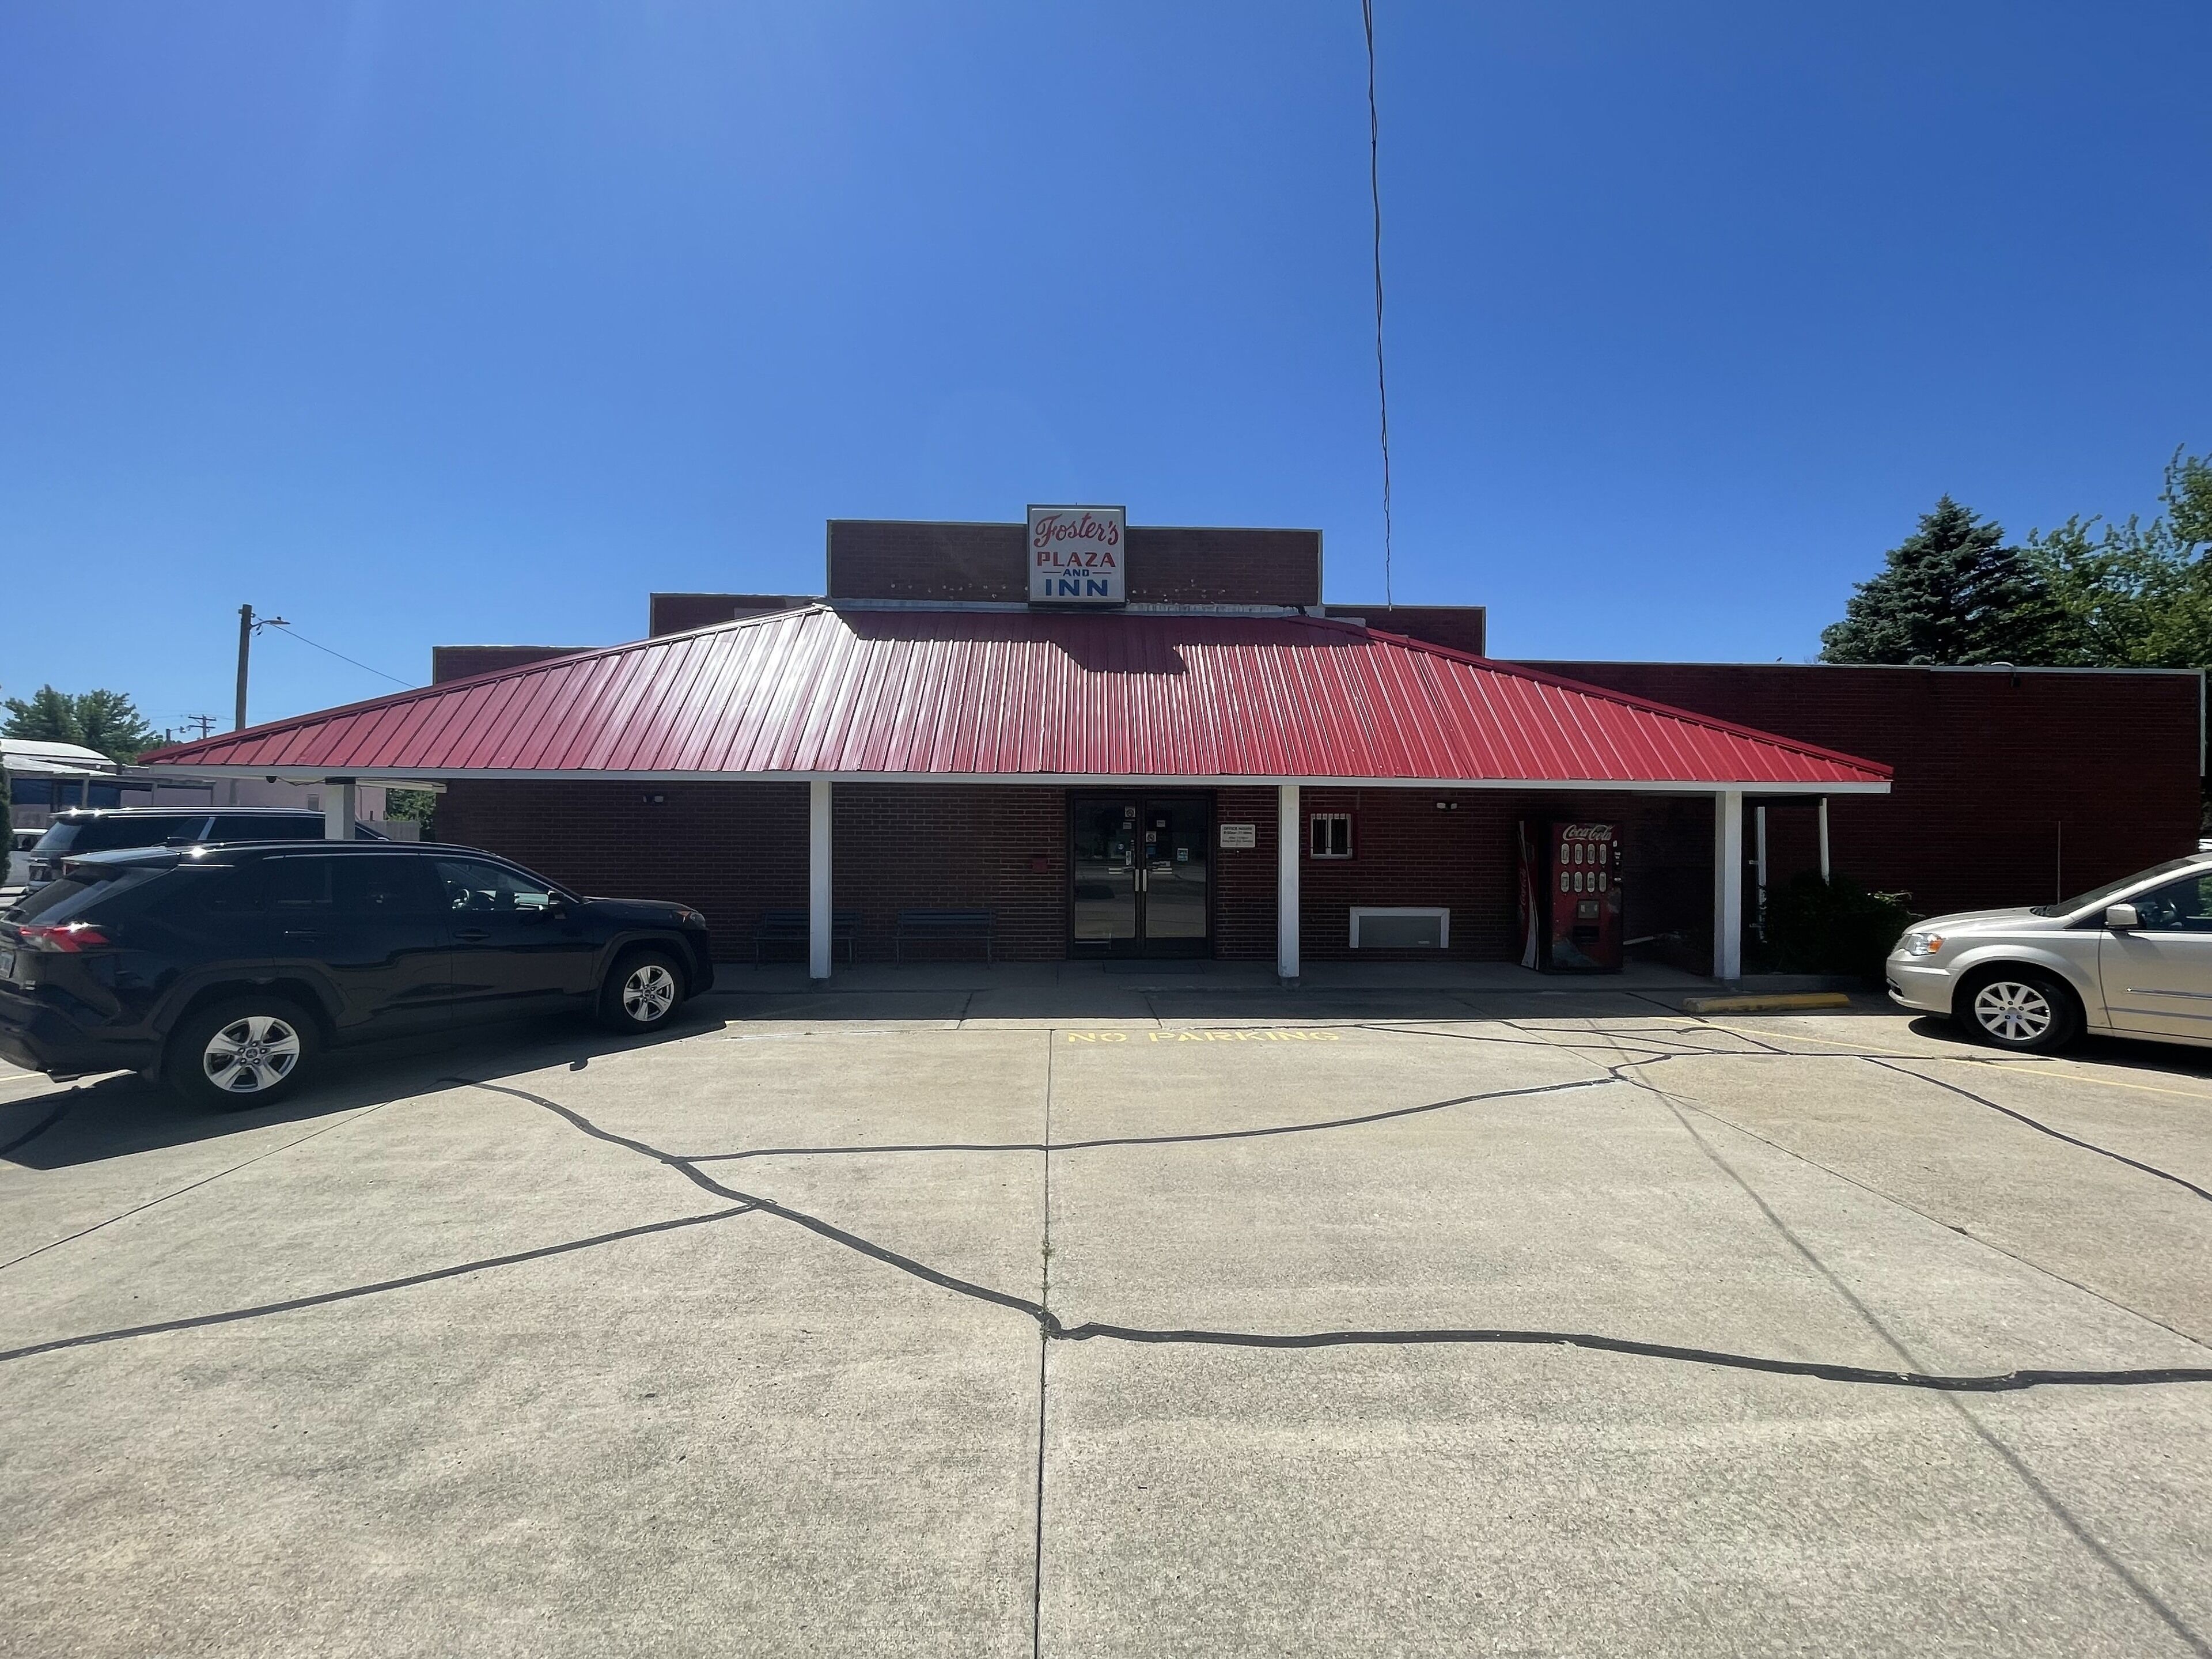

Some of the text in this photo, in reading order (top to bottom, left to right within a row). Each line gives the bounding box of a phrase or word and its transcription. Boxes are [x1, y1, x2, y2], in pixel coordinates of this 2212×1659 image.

[1033, 512, 1119, 547] Foster's
[1037, 551, 1116, 567] PLAZA
[1062, 569, 1090, 577] AND
[1046, 579, 1108, 596] INN
[1068, 1032, 1339, 1042] NO PARKING
